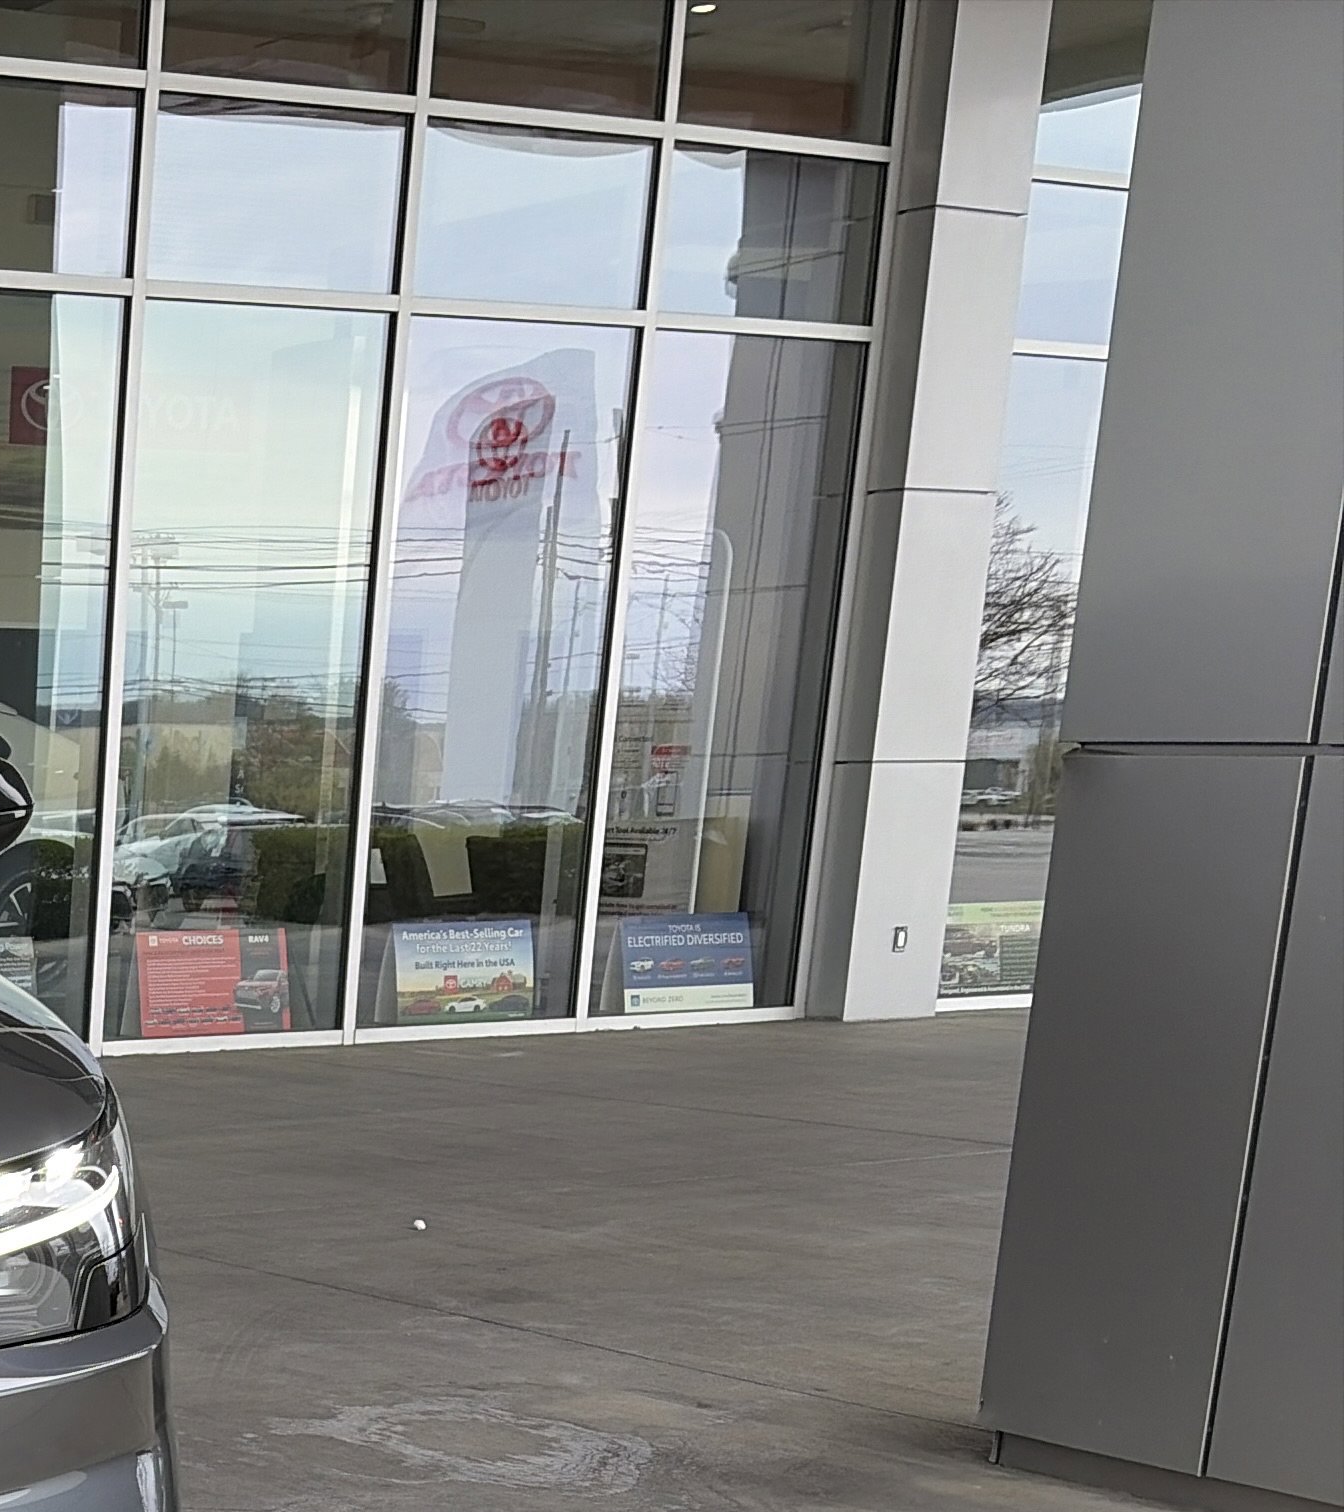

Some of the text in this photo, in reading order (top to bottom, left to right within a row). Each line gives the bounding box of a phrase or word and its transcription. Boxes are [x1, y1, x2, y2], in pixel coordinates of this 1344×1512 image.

[402, 927, 524, 941] America's Best-Selling Car
[668, 924, 694, 932] TOYOTA
[182, 934, 224, 946] CHOICES
[248, 935, 270, 943] RAV4
[627, 932, 744, 948] ELECTRIFIED DIVERSIFIED
[449, 942, 469, 953] Last
[484, 941, 512, 952] Years!
[435, 960, 456, 971] Right
[457, 960, 475, 969] Here
[485, 958, 498, 967] the
[499, 958, 515, 967] USA
